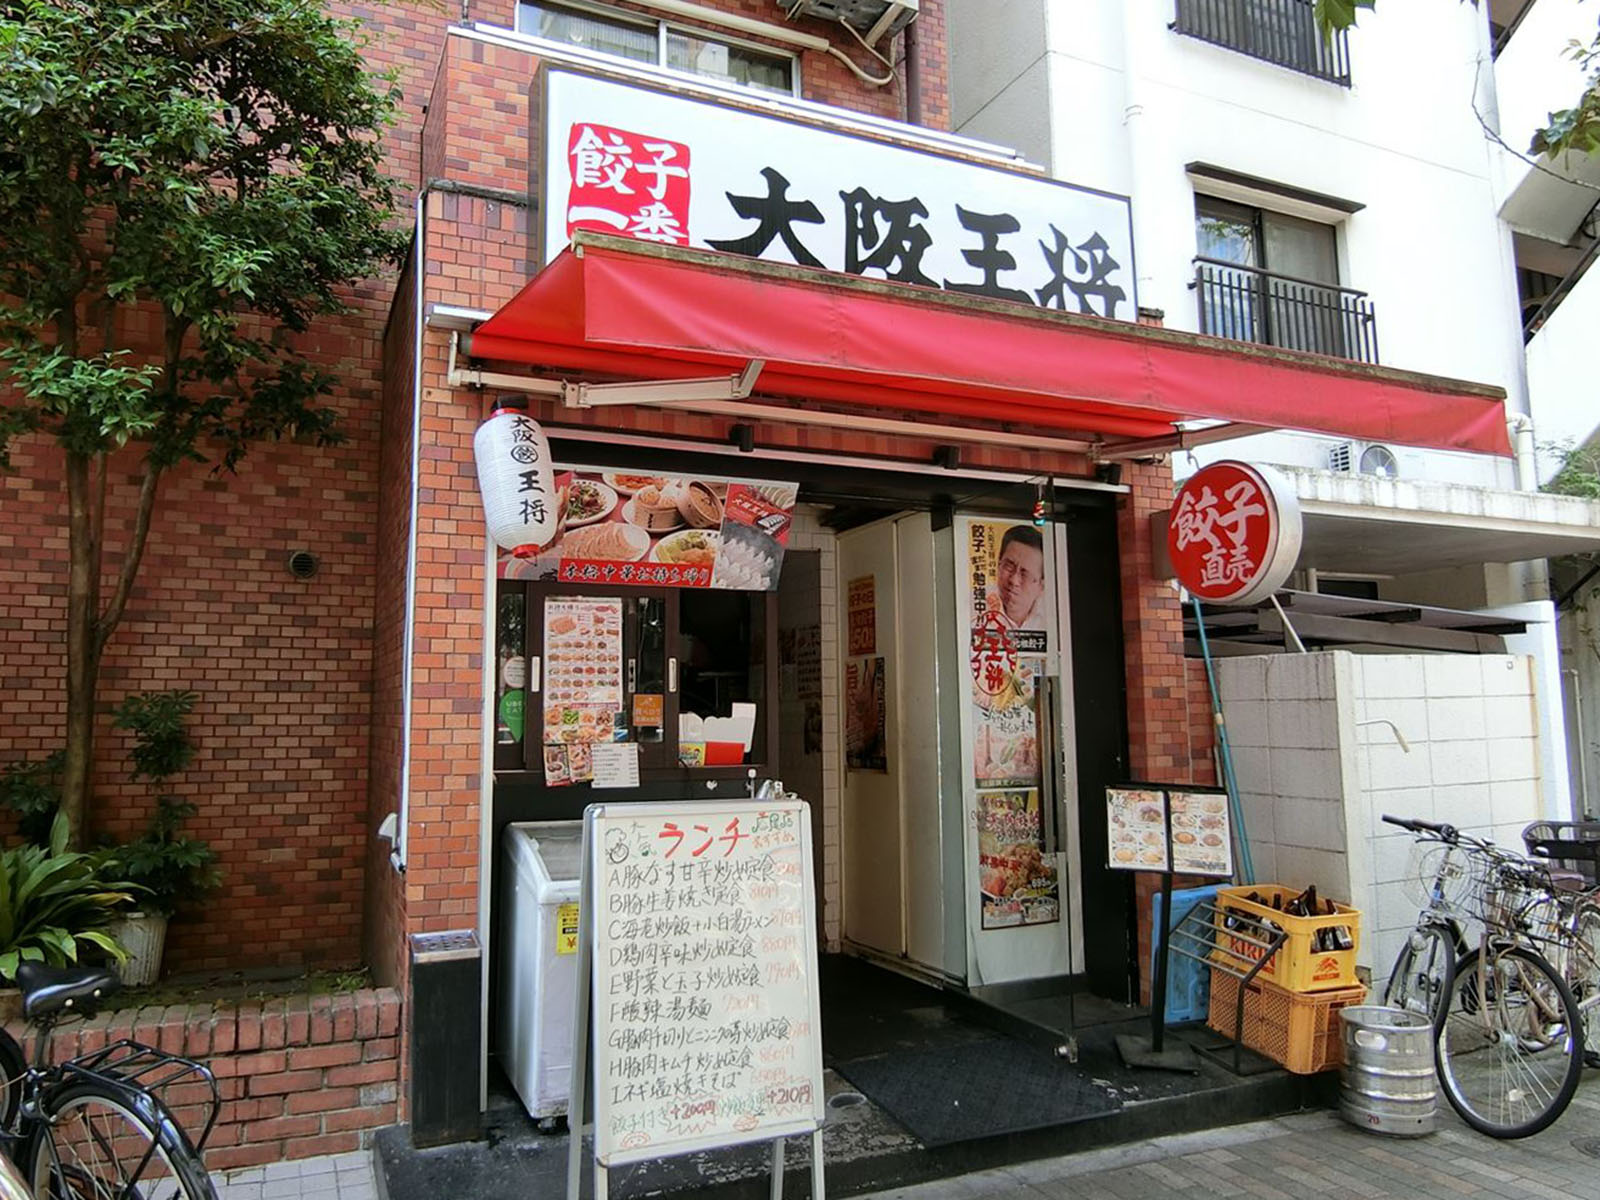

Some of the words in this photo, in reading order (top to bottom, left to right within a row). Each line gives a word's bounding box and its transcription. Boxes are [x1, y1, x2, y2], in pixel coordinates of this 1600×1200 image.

[570, 125, 690, 195] 餃子
[704, 166, 1126, 318] 大阪王将
[1171, 481, 1265, 551] 餃子
[564, 563, 709, 585] 本格中華お持ち帰り
[1201, 545, 1255, 587] 直売
[658, 817, 749, 858] ランチ
[767, 1085, 812, 1106] +210円
